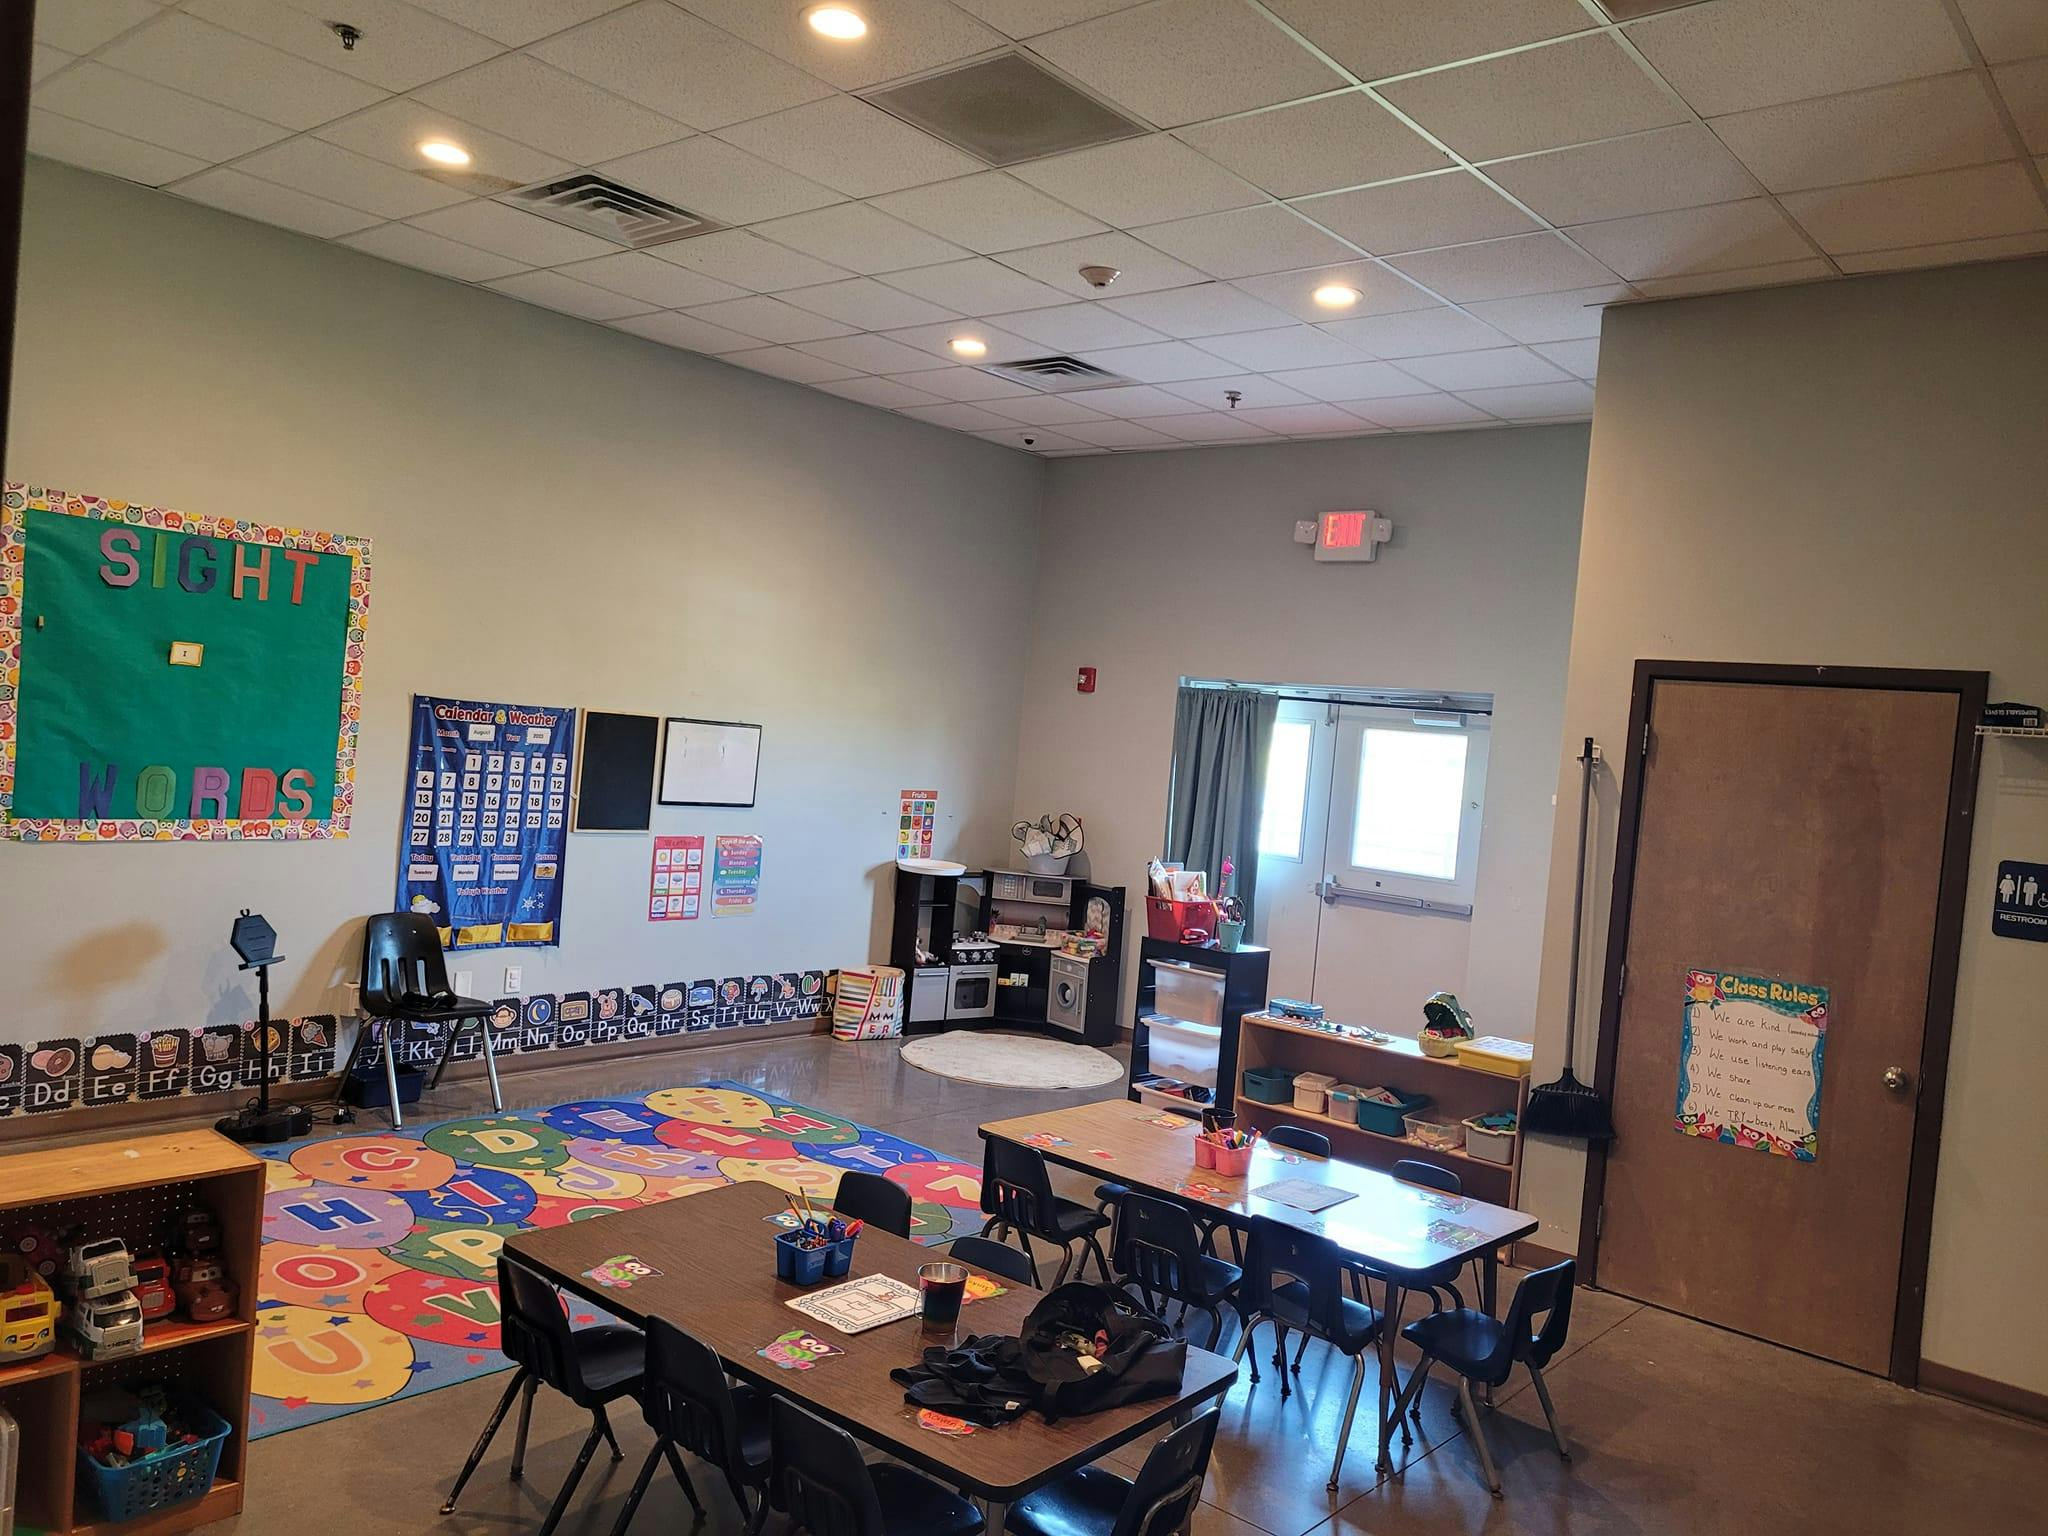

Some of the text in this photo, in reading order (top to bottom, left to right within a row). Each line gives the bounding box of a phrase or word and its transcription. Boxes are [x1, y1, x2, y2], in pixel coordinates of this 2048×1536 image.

[99, 528, 320, 605] SIGHT
[435, 704, 494, 724] Calendar
[509, 710, 558, 728] Weather
[79, 762, 315, 820] WORDS
[511, 779, 521, 788] 10
[533, 780, 541, 789] 11
[553, 780, 562, 789] 12
[911, 791, 928, 799] Fruits
[418, 794, 561, 807] 13 14 15 16 17 18 19
[415, 813, 560, 825] 20 21 22 23 24 25 26
[413, 833, 516, 843] 27 28 29 30 31
[411, 853, 434, 862] Today
[491, 853, 522, 862] Tomorrow
[2000, 912, 2048, 926] RESTROOM
[1720, 975, 1819, 1006] Class Rules
[1713, 1010, 1731, 1024] We
[1737, 1019, 1755, 1028] are
[34, 1080, 70, 1106] Dd
[94, 1076, 126, 1098] Ee
[149, 1068, 180, 1092] Ff
[200, 1065, 232, 1089] Gg
[409, 1040, 435, 1061] Kk
[527, 1027, 549, 1046] Nn
[562, 1025, 585, 1043] Oo
[597, 1020, 618, 1041] Pp
[628, 1017, 651, 1036] Qq
[661, 1014, 680, 1031] Rr
[692, 1010, 709, 1026] Ss
[748, 1004, 766, 1020] Uu
[775, 1002, 792, 1017] Vv
[798, 998, 820, 1014] Ww
[1709, 1027, 1724, 1041] We
[1752, 1040, 1768, 1049] and
[1771, 1043, 1786, 1055] play
[1707, 1066, 1722, 1080] We
[1709, 1047, 1725, 1060] We
[1731, 1056, 1750, 1065] use
[1755, 1056, 1787, 1076] listening
[1705, 1084, 1722, 1099] We
[1752, 1100, 1761, 1109] up
[579, 1109, 653, 1132] E
[760, 1113, 837, 1135] M
[1704, 1104, 1720, 1118] We
[1727, 1109, 1746, 1121] TRY
[471, 1129, 539, 1153] D
[690, 1127, 756, 1147] L
[341, 1146, 421, 1173] C
[602, 1145, 696, 1169] K
[829, 1145, 898, 1169] T
[764, 1162, 837, 1186] S
[279, 1197, 382, 1232] H
[428, 1229, 504, 1267] P
[272, 1254, 368, 1289] O
[265, 1326, 371, 1376] U
